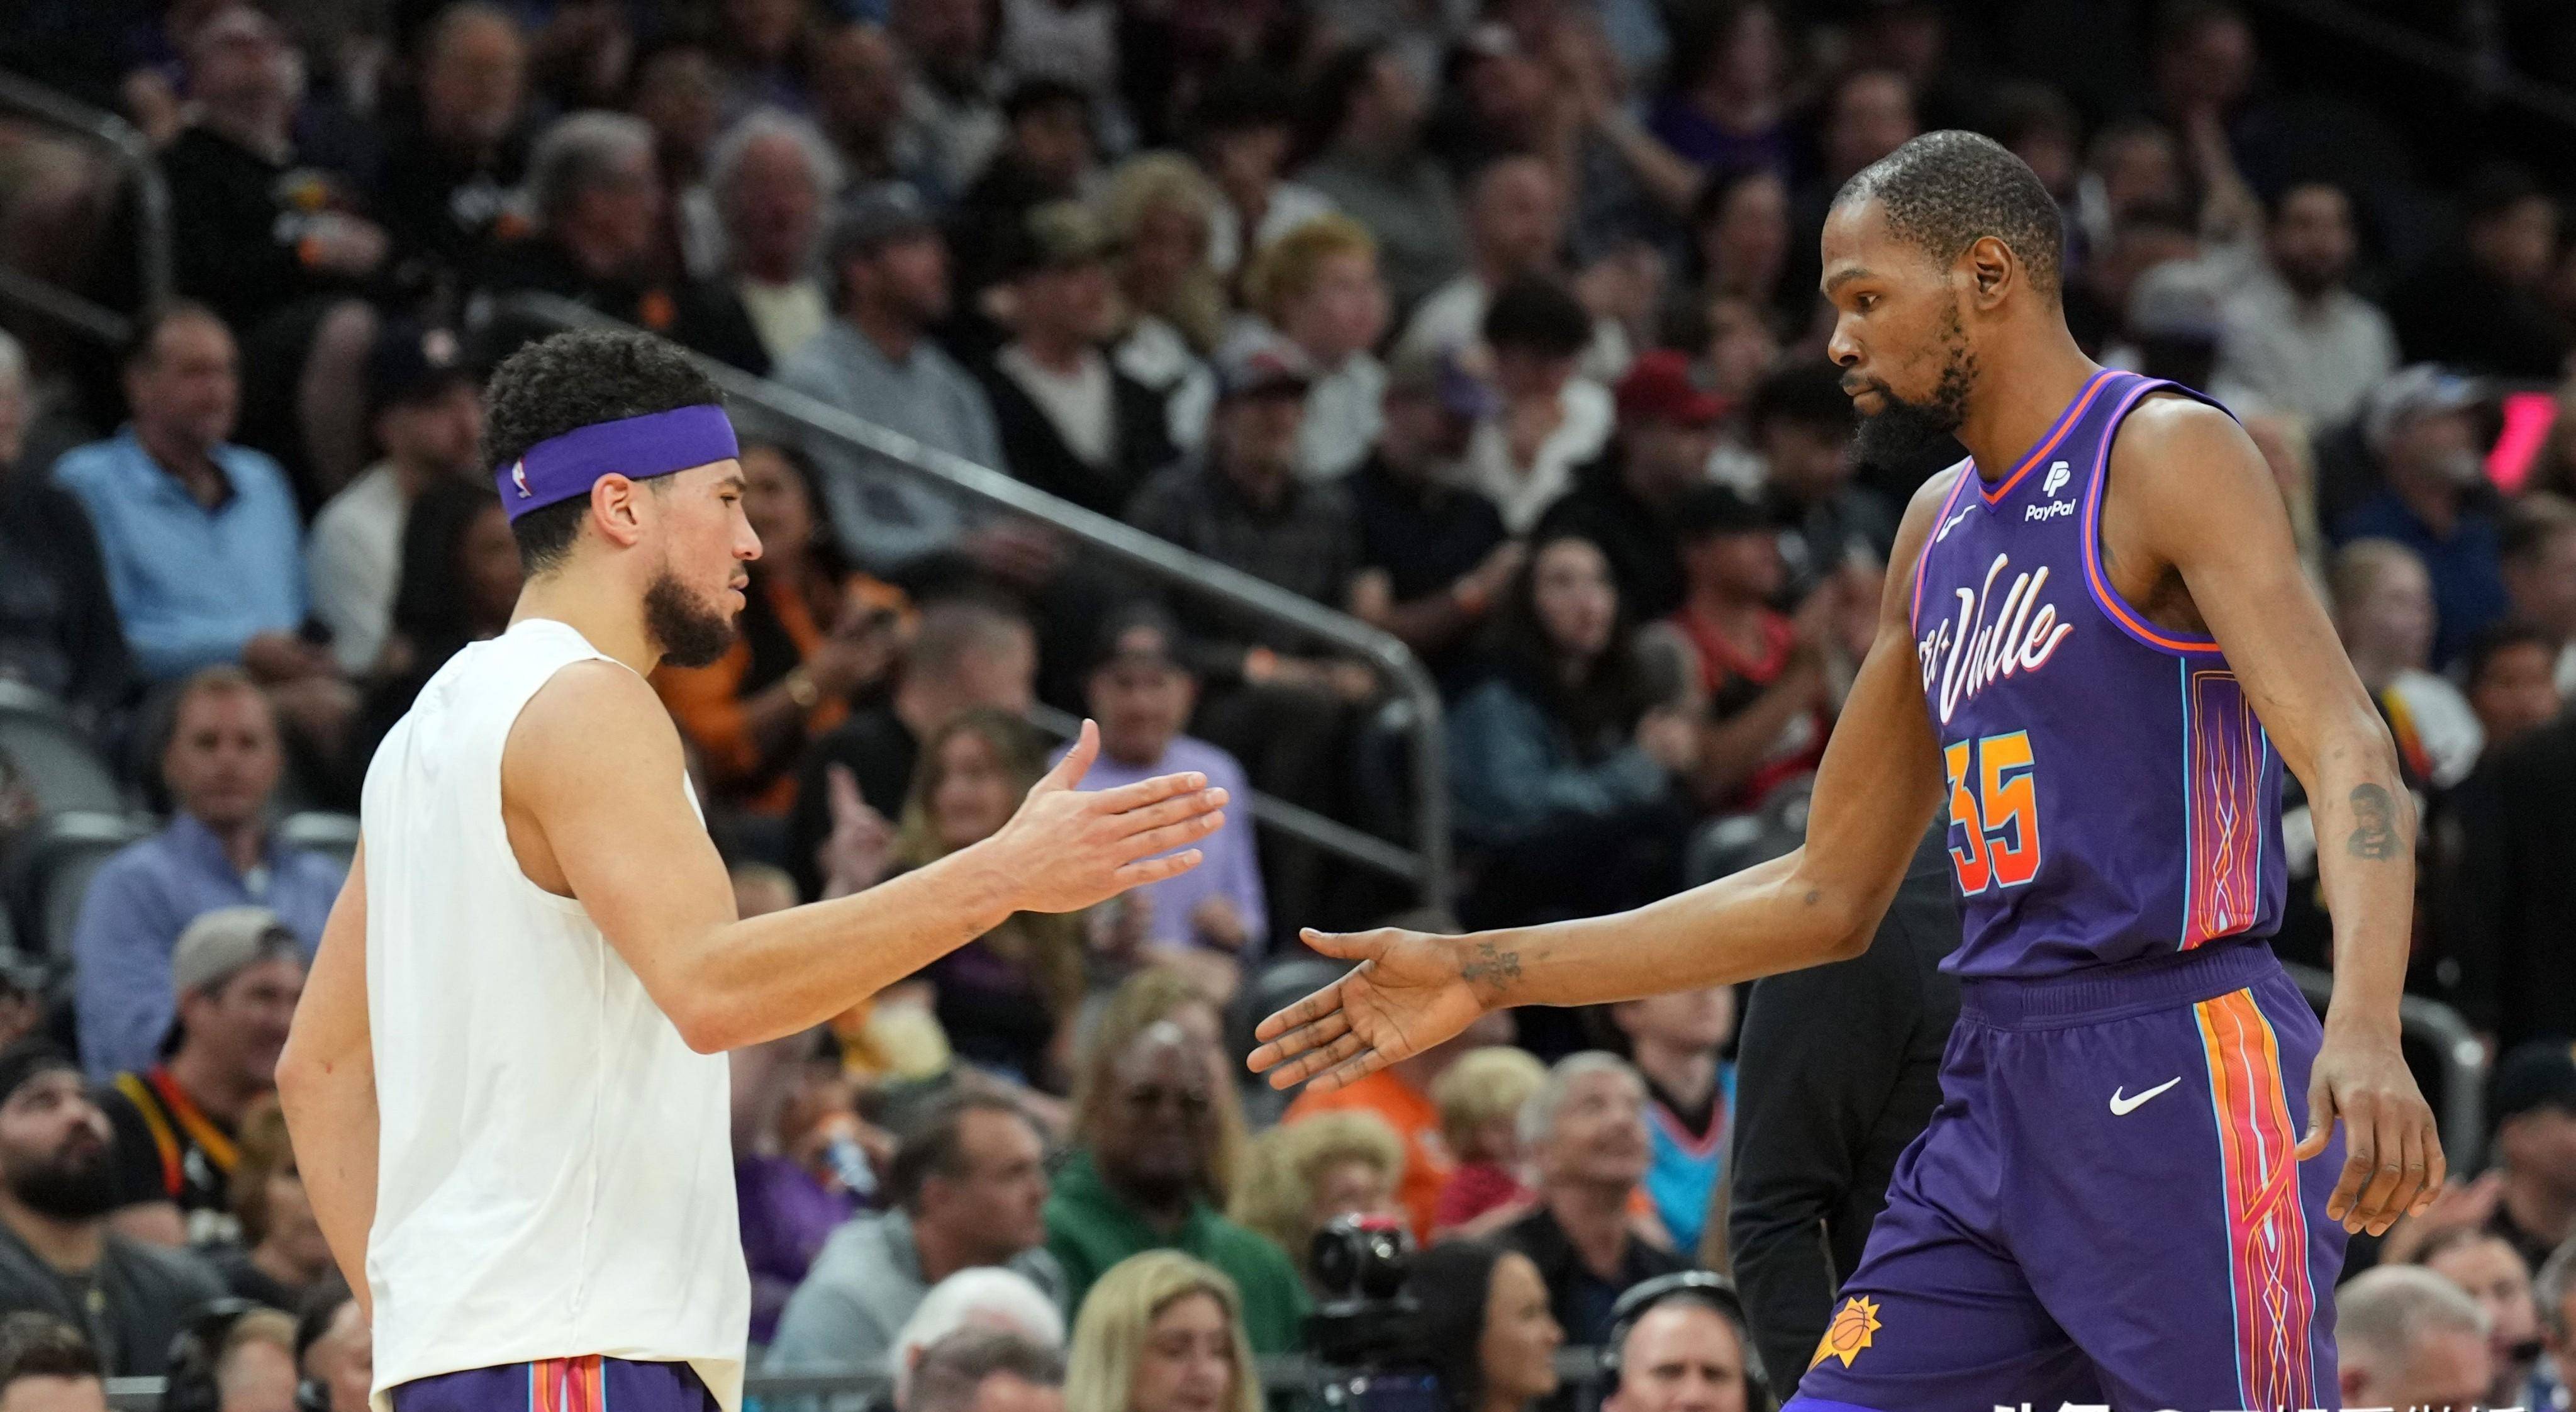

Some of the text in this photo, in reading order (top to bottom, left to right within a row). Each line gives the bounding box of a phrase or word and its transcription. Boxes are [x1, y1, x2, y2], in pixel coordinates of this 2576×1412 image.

[2025, 498, 2076, 522] PayPal
[1940, 552, 2073, 725] Valle
[1944, 729, 2039, 897] 35
